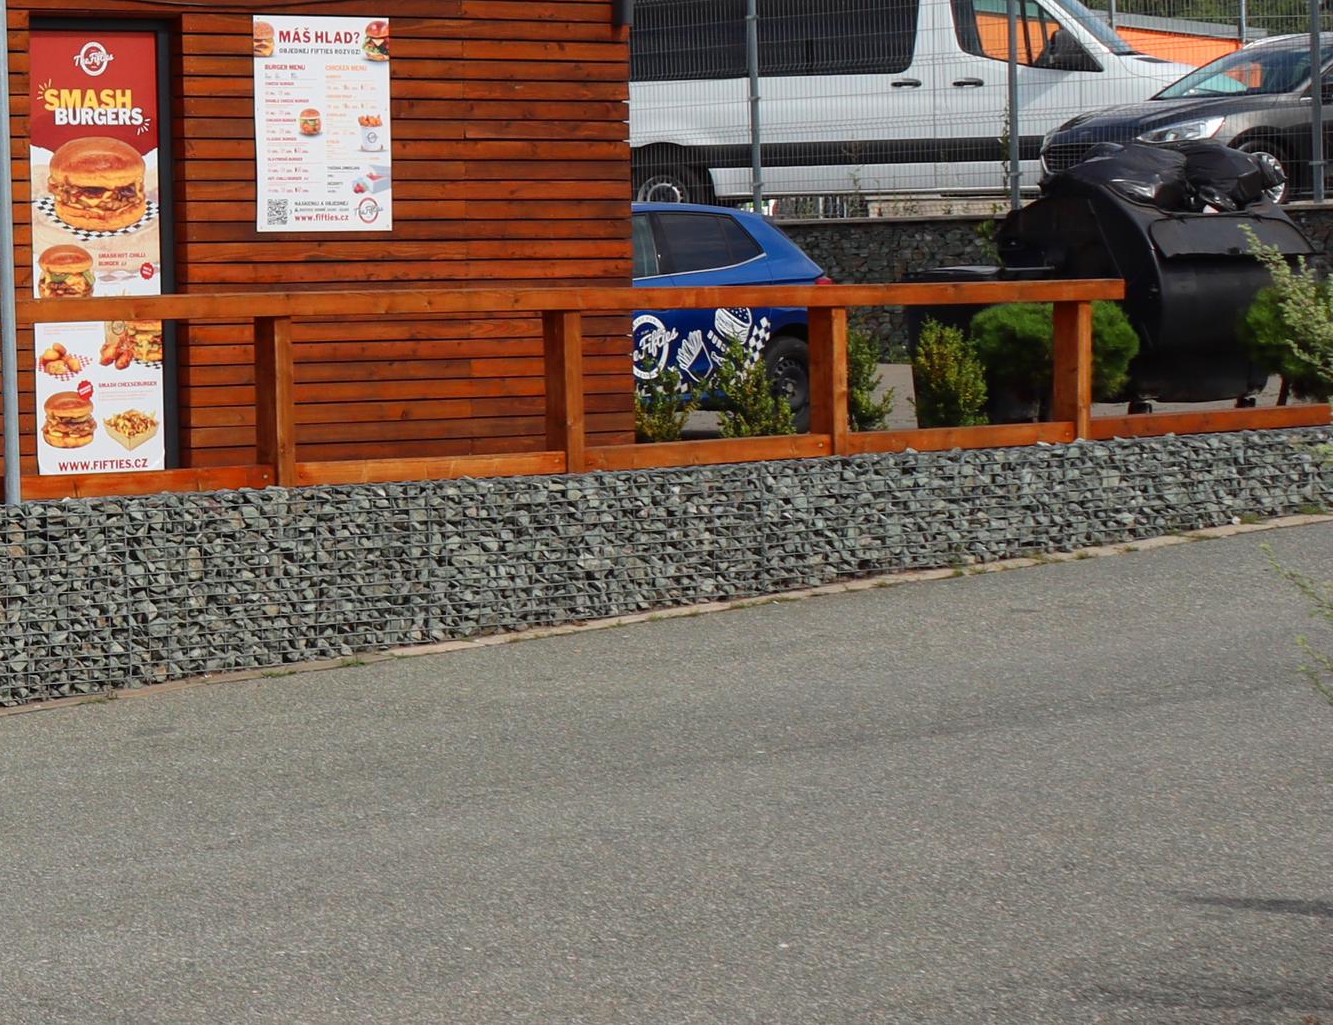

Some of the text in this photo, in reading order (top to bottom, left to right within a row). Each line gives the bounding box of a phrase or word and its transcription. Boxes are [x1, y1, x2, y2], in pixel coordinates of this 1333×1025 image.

[278, 27, 361, 45] MÁŠ HLAD?
[44, 88, 132, 111] SMASH
[54, 108, 143, 126] BURGERS
[58, 458, 149, 472] WWW.FIFTIES.CZ
